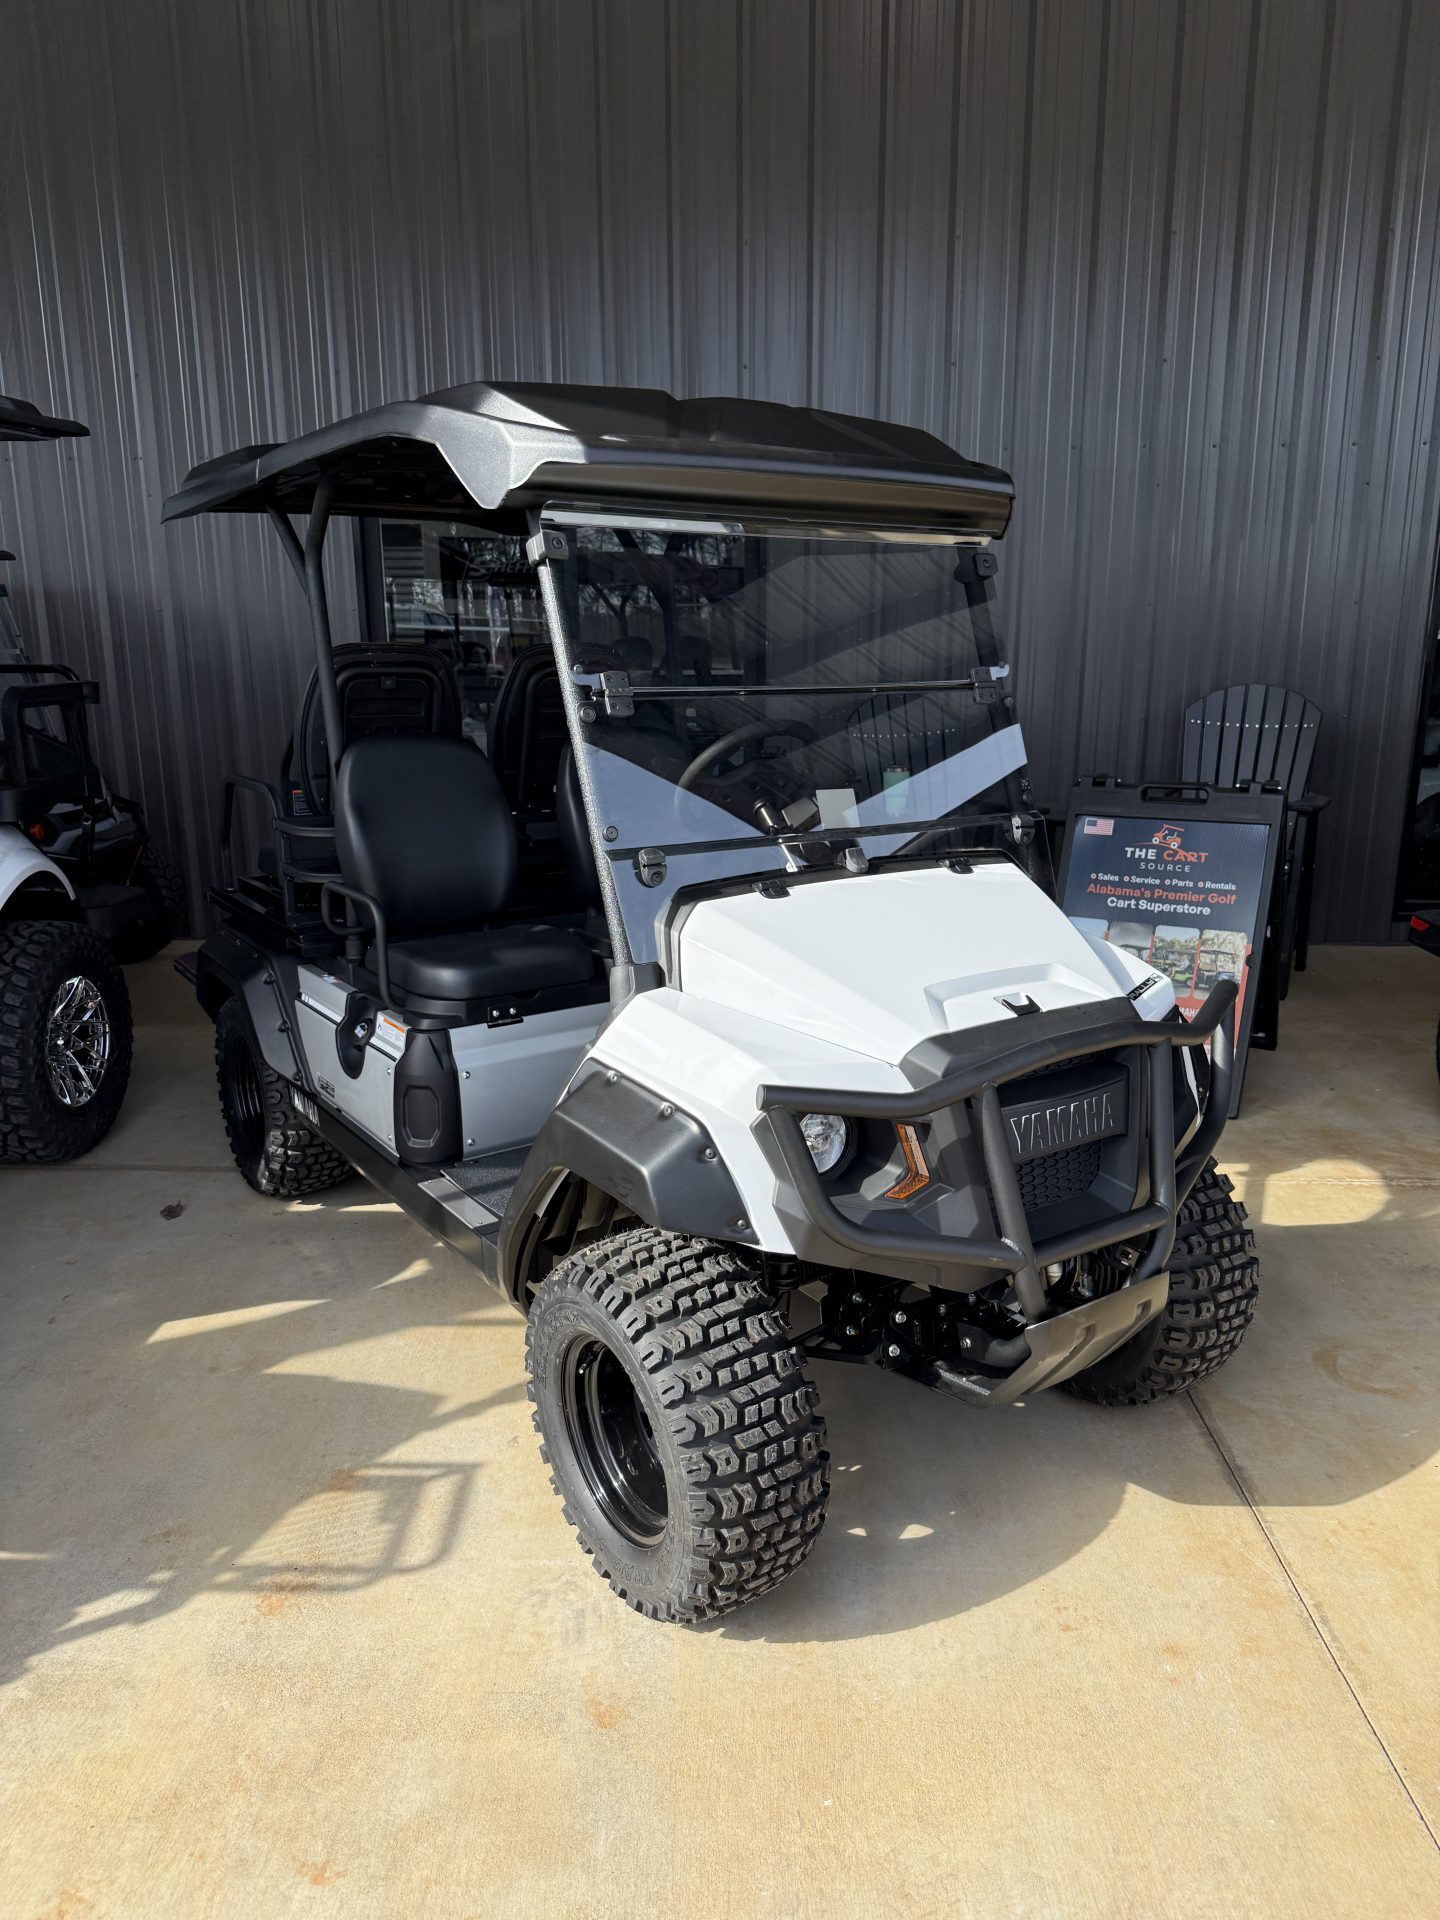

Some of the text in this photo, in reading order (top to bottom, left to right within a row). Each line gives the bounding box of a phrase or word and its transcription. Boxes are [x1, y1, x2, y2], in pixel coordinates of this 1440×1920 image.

[1125, 847, 1209, 863] THE CART
[1139, 862, 1191, 873] SOURCE
[1098, 873, 1236, 890] Sales Service Parts Rentals
[1087, 883, 1237, 905] Alabama's Premier Golf
[1107, 897, 1211, 915] Cart Superstore
[1010, 1092, 1114, 1154] YAMAHA
